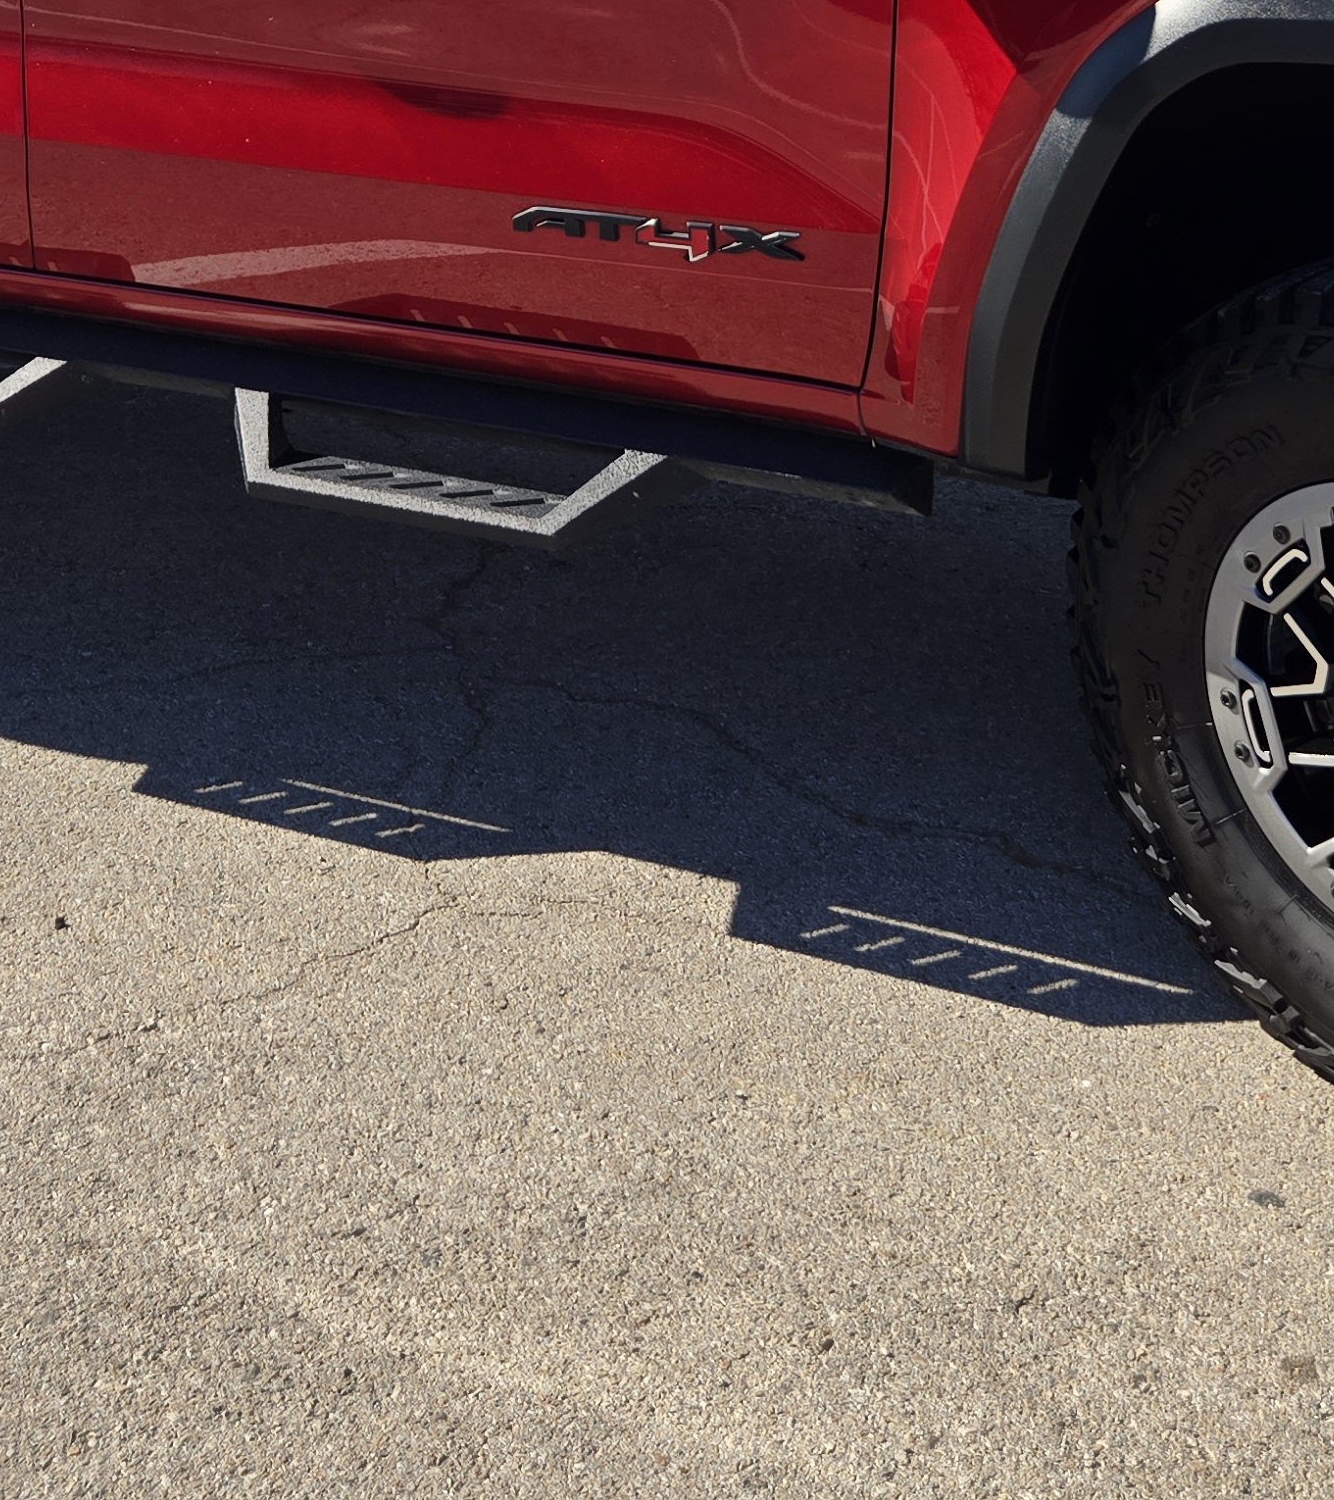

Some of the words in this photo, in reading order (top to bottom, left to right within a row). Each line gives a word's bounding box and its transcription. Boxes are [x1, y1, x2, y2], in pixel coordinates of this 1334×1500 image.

[512, 205, 806, 263] AT4X
[1138, 424, 1285, 603] THOMPSON
[1136, 648, 1217, 847] MICKEY
